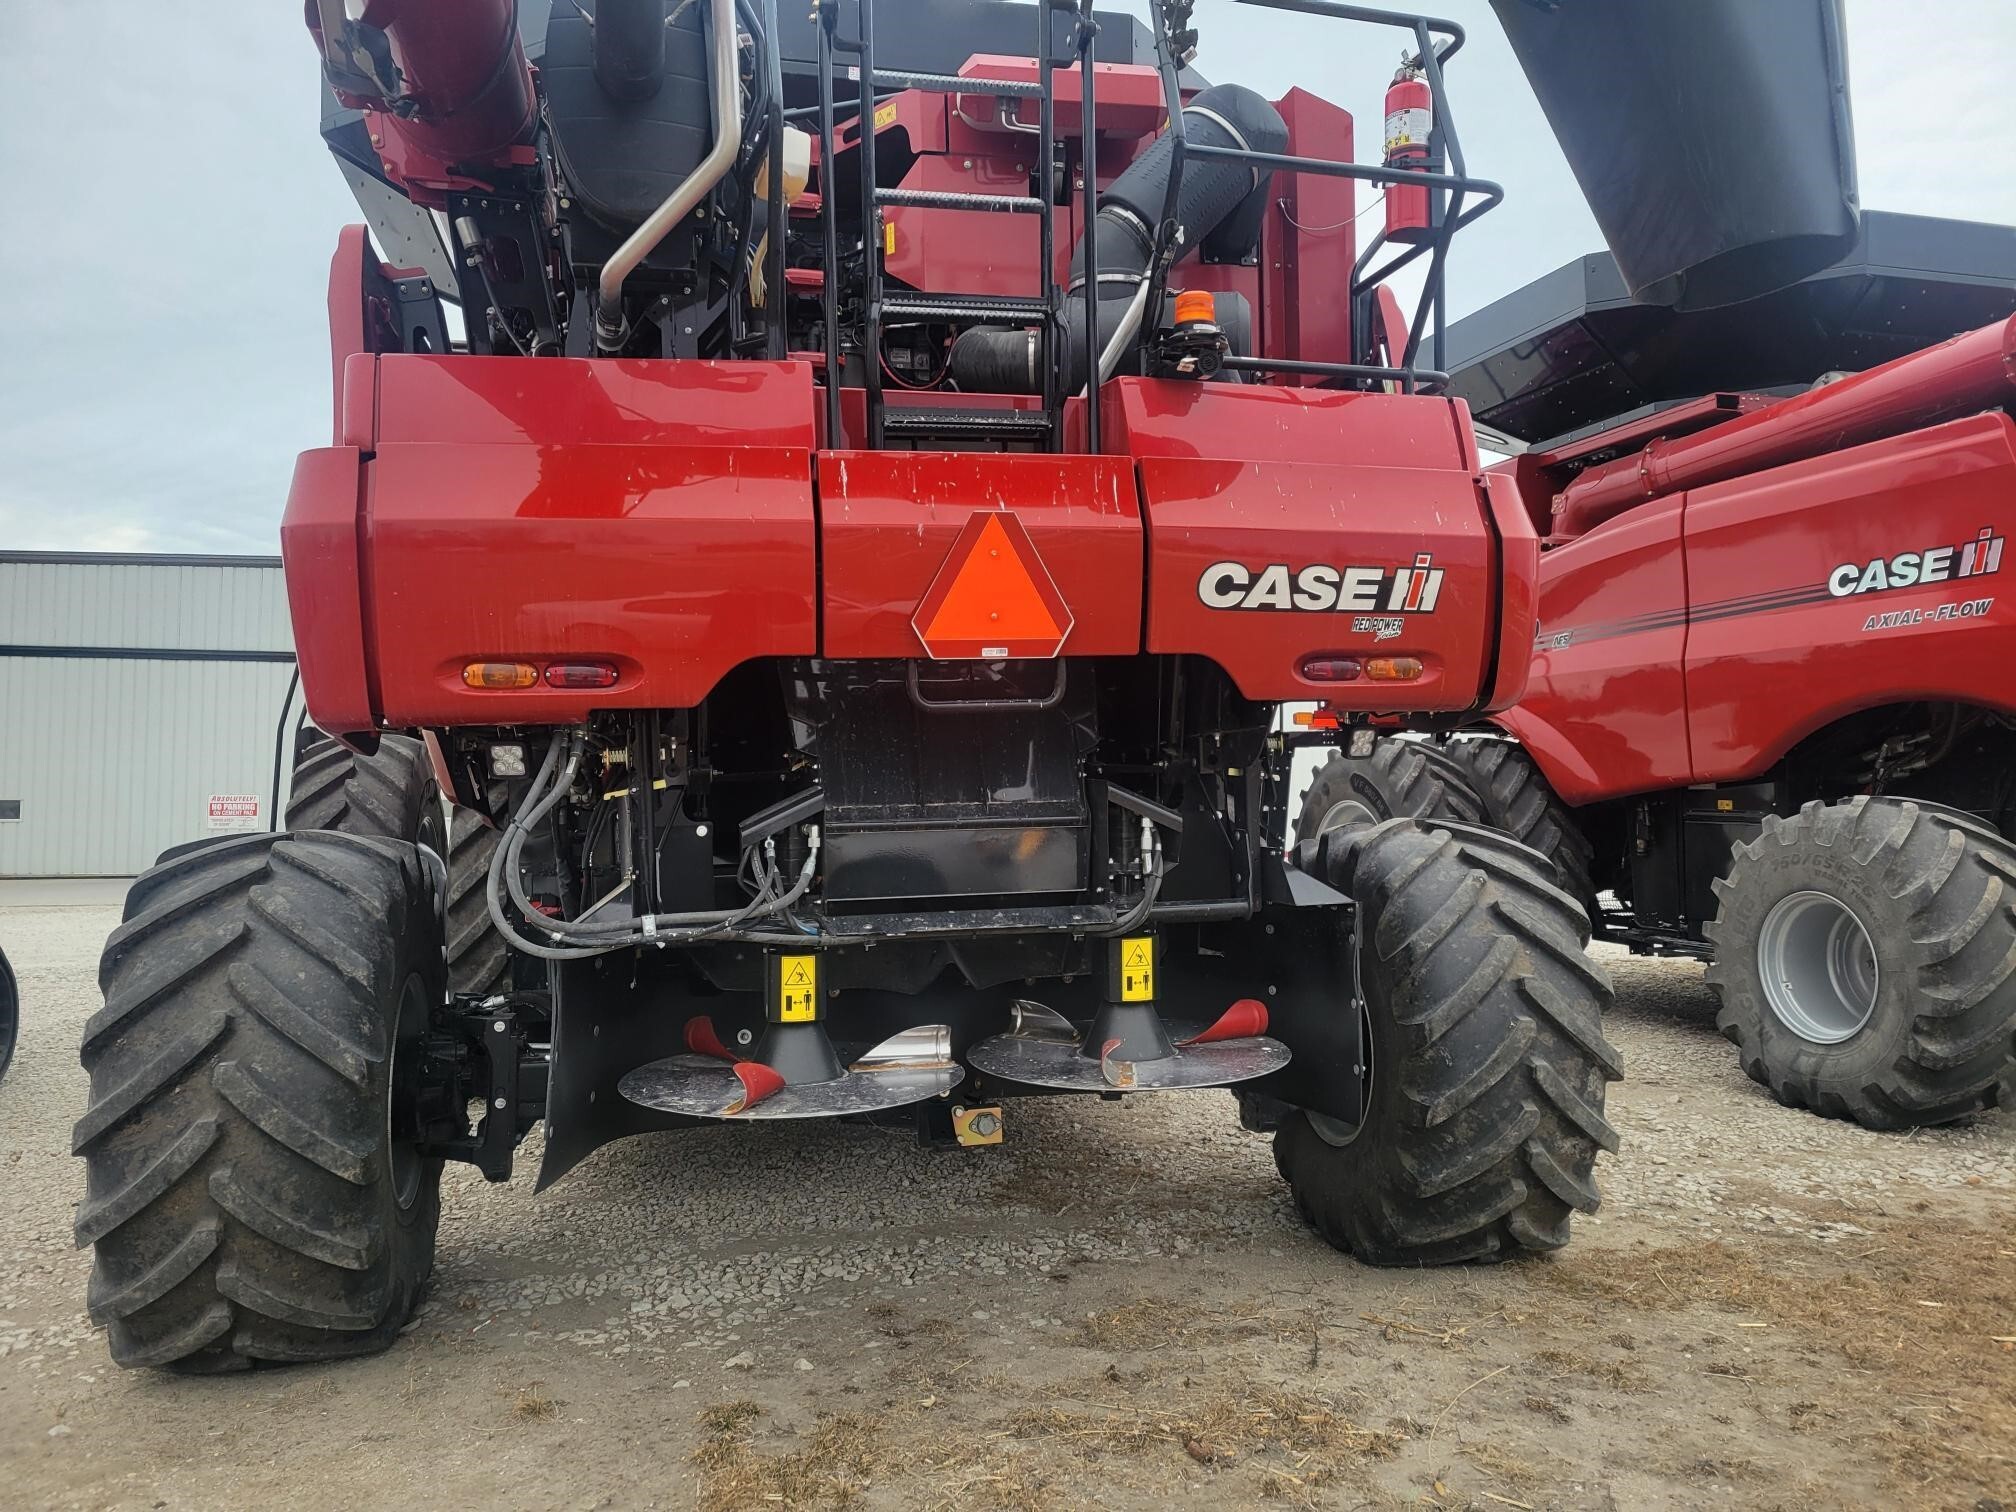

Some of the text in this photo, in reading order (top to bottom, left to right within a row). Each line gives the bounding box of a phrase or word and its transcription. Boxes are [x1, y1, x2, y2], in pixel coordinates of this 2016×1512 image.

[1198, 562, 1383, 611] CASE
[1829, 546, 1954, 597] CASE
[1352, 616, 1404, 633] RED POWER
[1863, 598, 1994, 632] AXIAL-FLOW
[211, 803, 256, 811] NO PARKING
